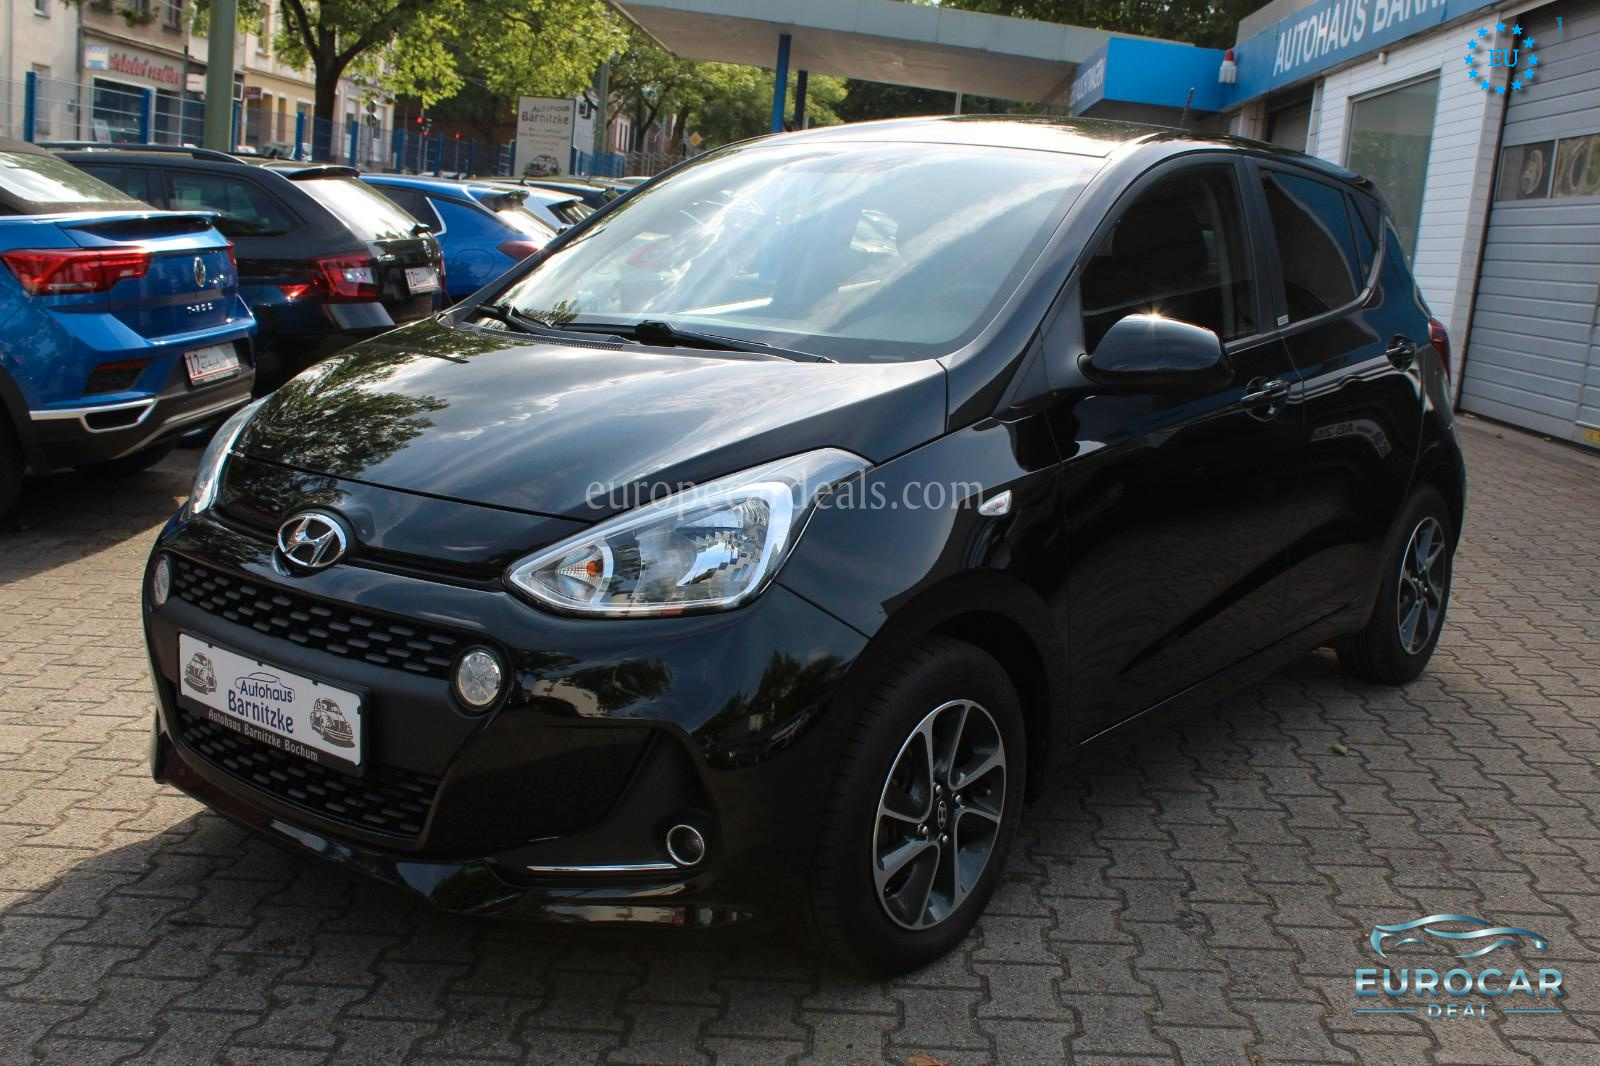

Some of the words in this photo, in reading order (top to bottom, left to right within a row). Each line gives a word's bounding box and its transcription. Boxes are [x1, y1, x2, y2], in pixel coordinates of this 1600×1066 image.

[1273, 0, 1369, 76] AUTOHAUS
[521, 111, 570, 125] Barnitzke
[227, 689, 295, 734] Barnitzke
[239, 679, 294, 703] Autohaus
[208, 708, 241, 732] Autohaus
[244, 724, 281, 748] Barnitzke
[284, 740, 318, 762] Bochum
